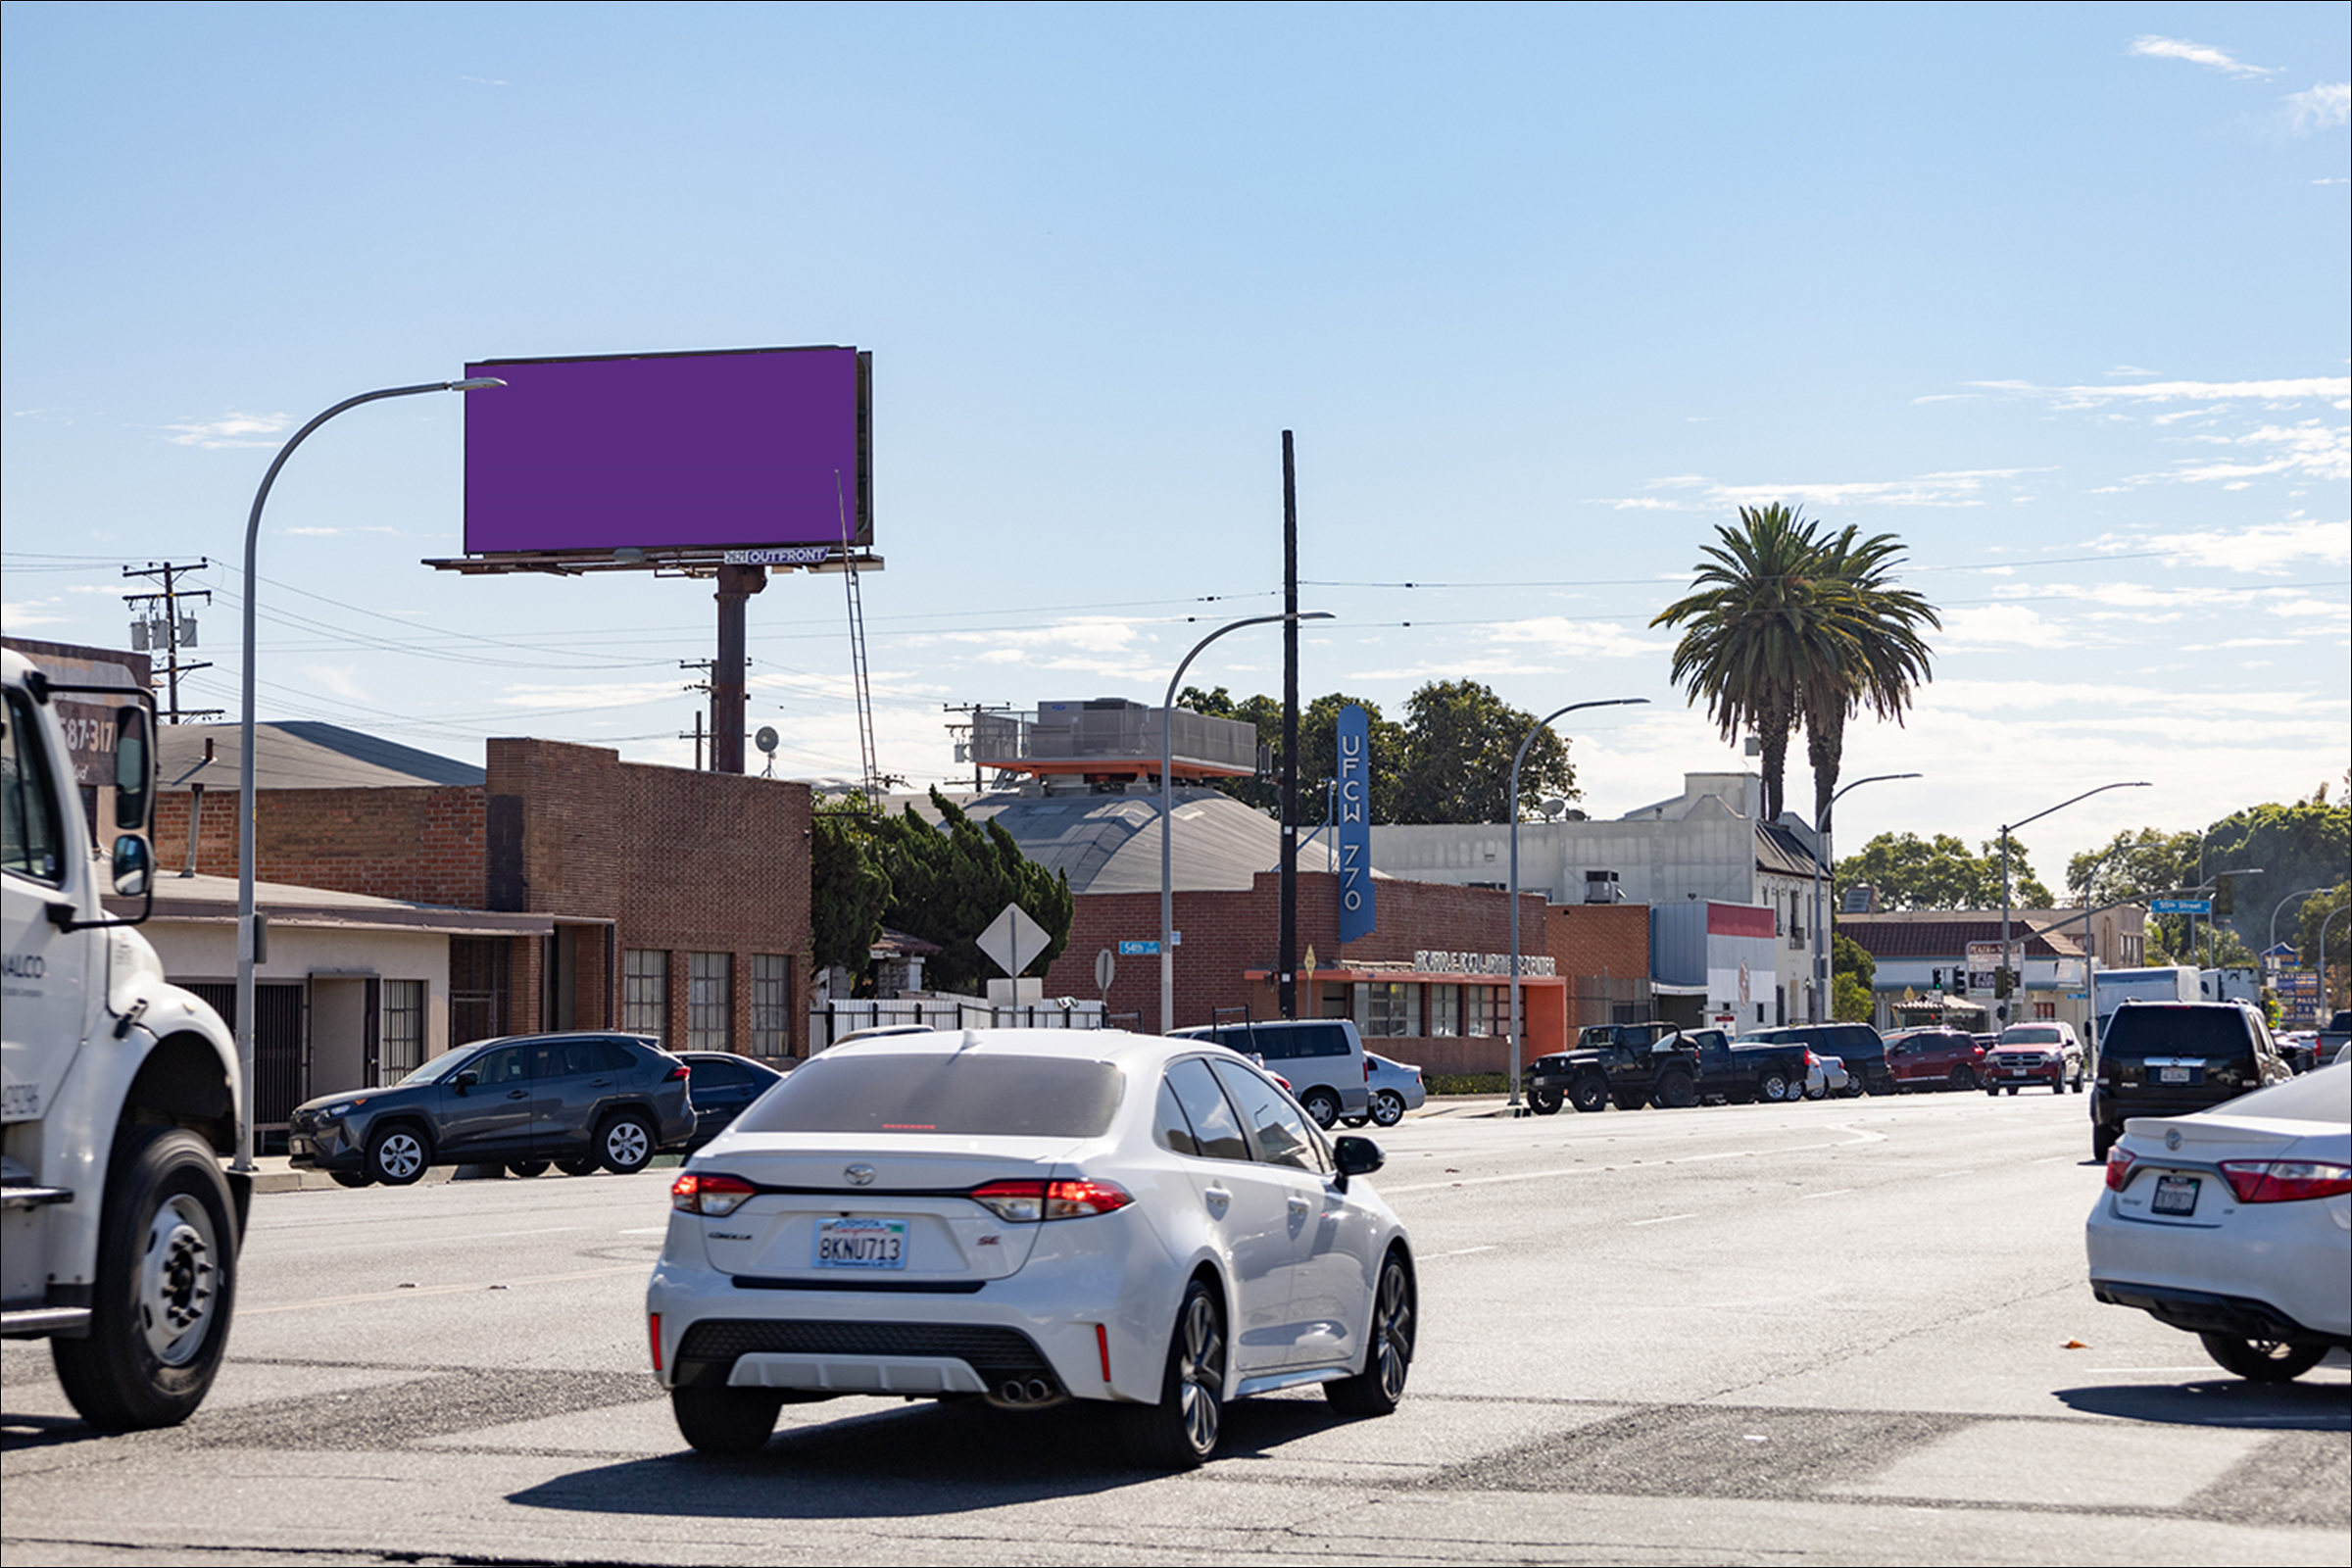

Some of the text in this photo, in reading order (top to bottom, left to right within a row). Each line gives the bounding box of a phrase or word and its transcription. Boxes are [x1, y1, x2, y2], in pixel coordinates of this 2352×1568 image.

[751, 548, 823, 563] OUTFRONT
[1342, 735, 1361, 911] UFCW 770
[2179, 902, 2201, 910] Street
[1124, 942, 1144, 954] 54th
[977, 1236, 1001, 1246] SE
[819, 1237, 901, 1261] 8KNU713
